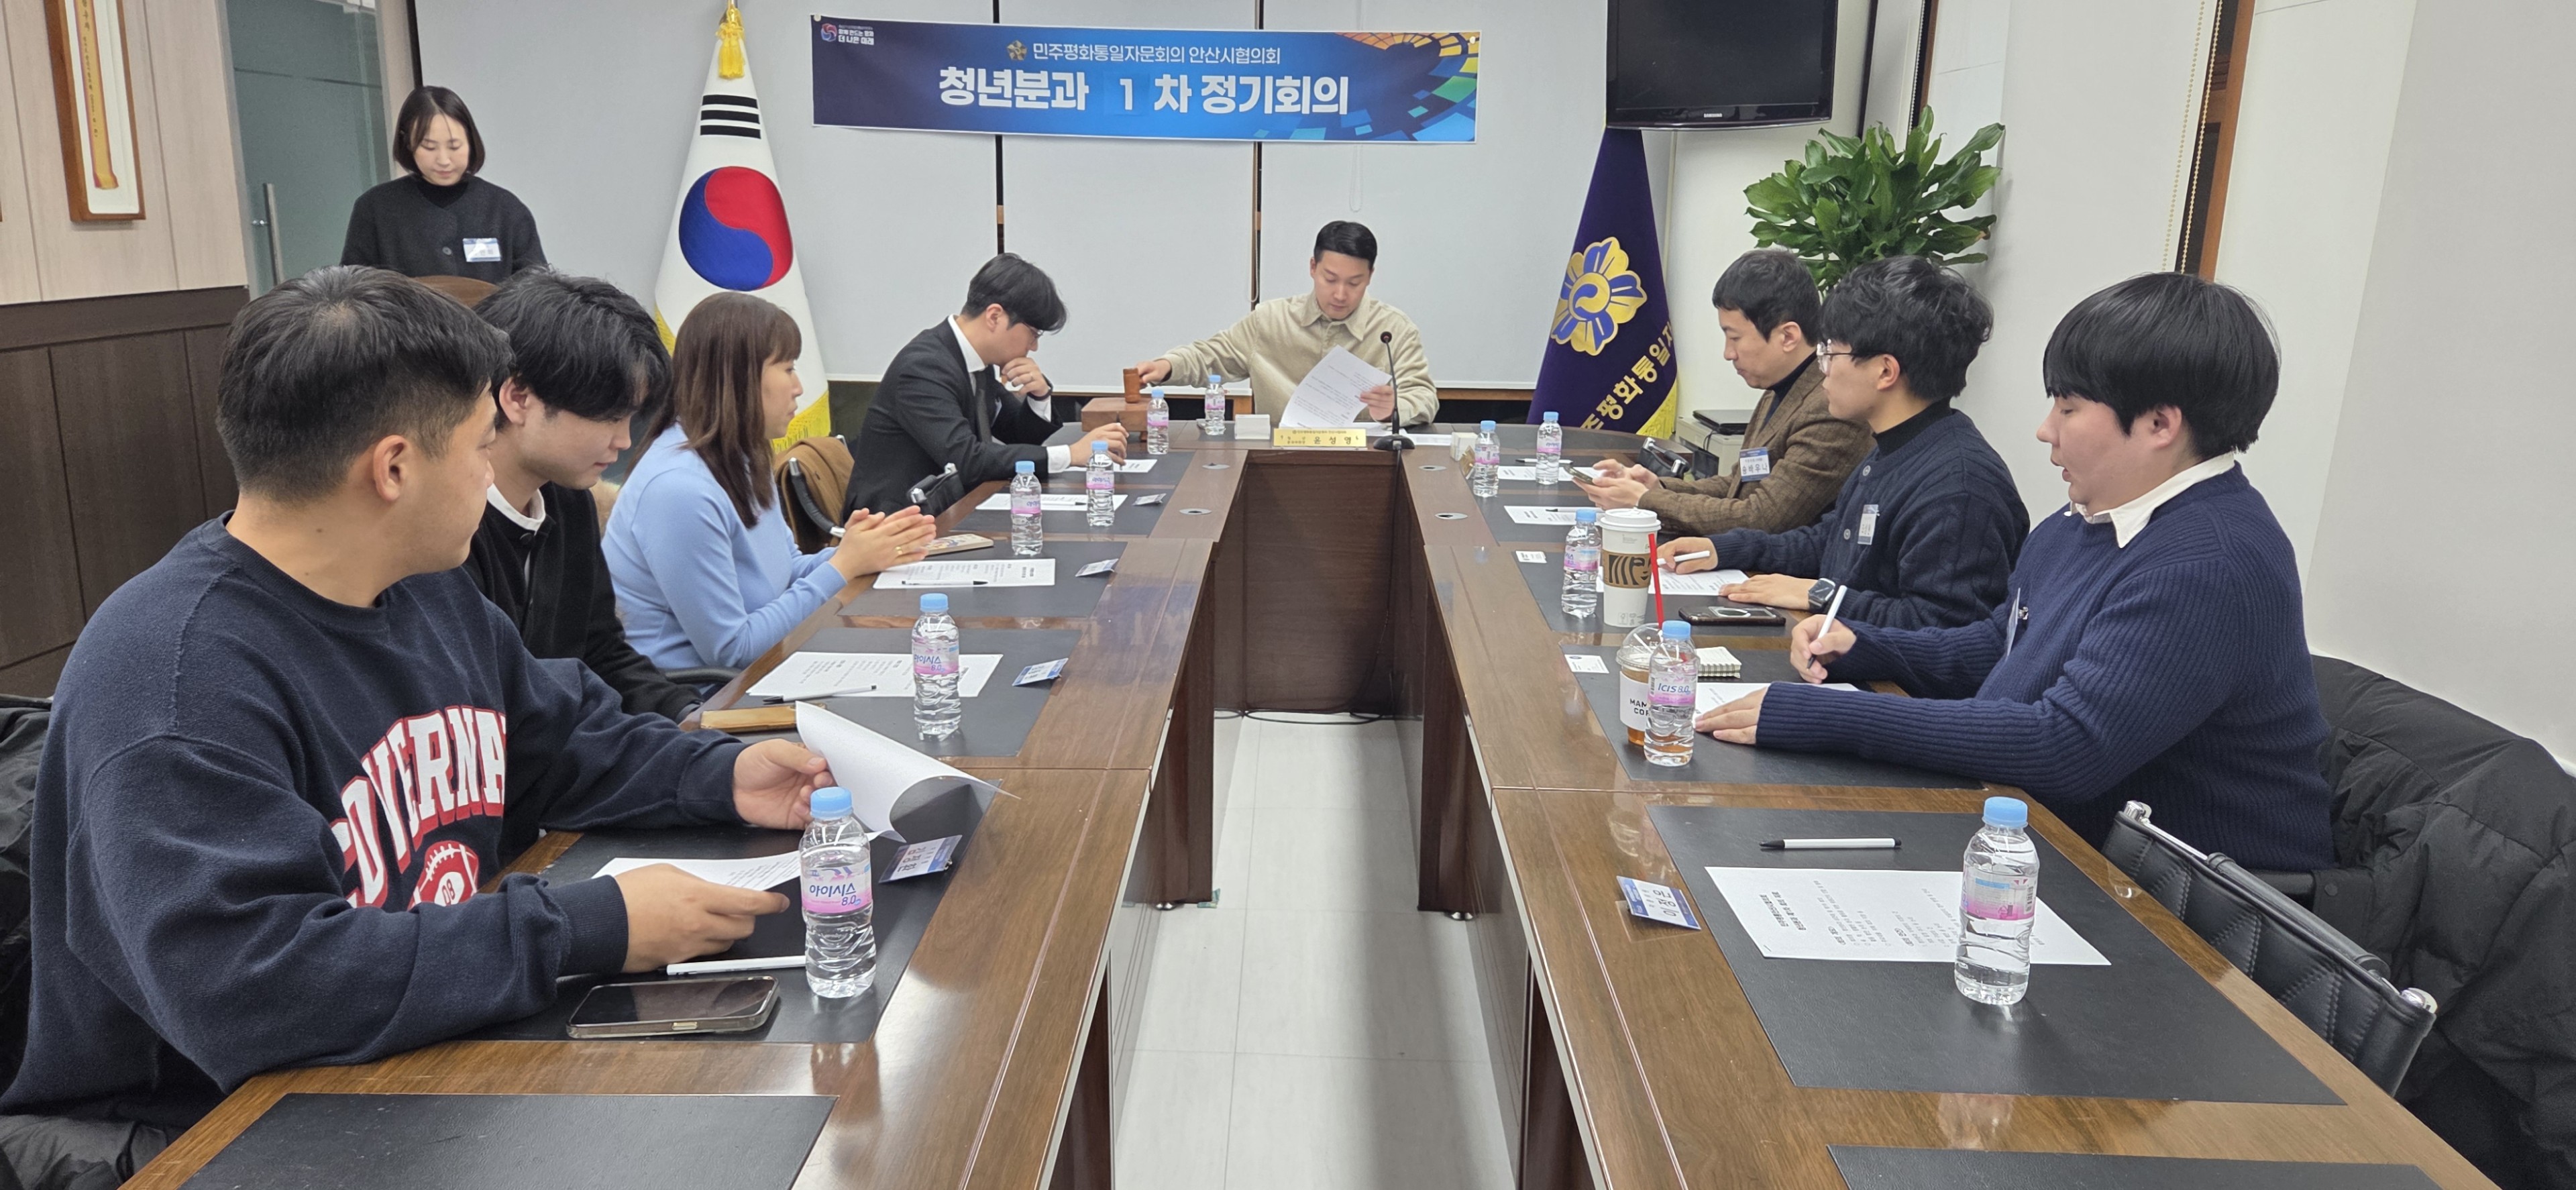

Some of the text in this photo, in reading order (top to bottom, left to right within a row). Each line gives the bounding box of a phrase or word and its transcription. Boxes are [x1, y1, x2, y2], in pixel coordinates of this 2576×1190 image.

[846, 36, 859, 44] 나은
[861, 37, 874, 45] 미래
[1032, 43, 1281, 64] 민주평화통일자문회의 안산시협의회
[939, 66, 1348, 115] 청년분과 1 차 정기회의
[1658, 683, 1678, 693] ICIS
[809, 882, 857, 898] 아이시스
[841, 894, 857, 906] 8.0
